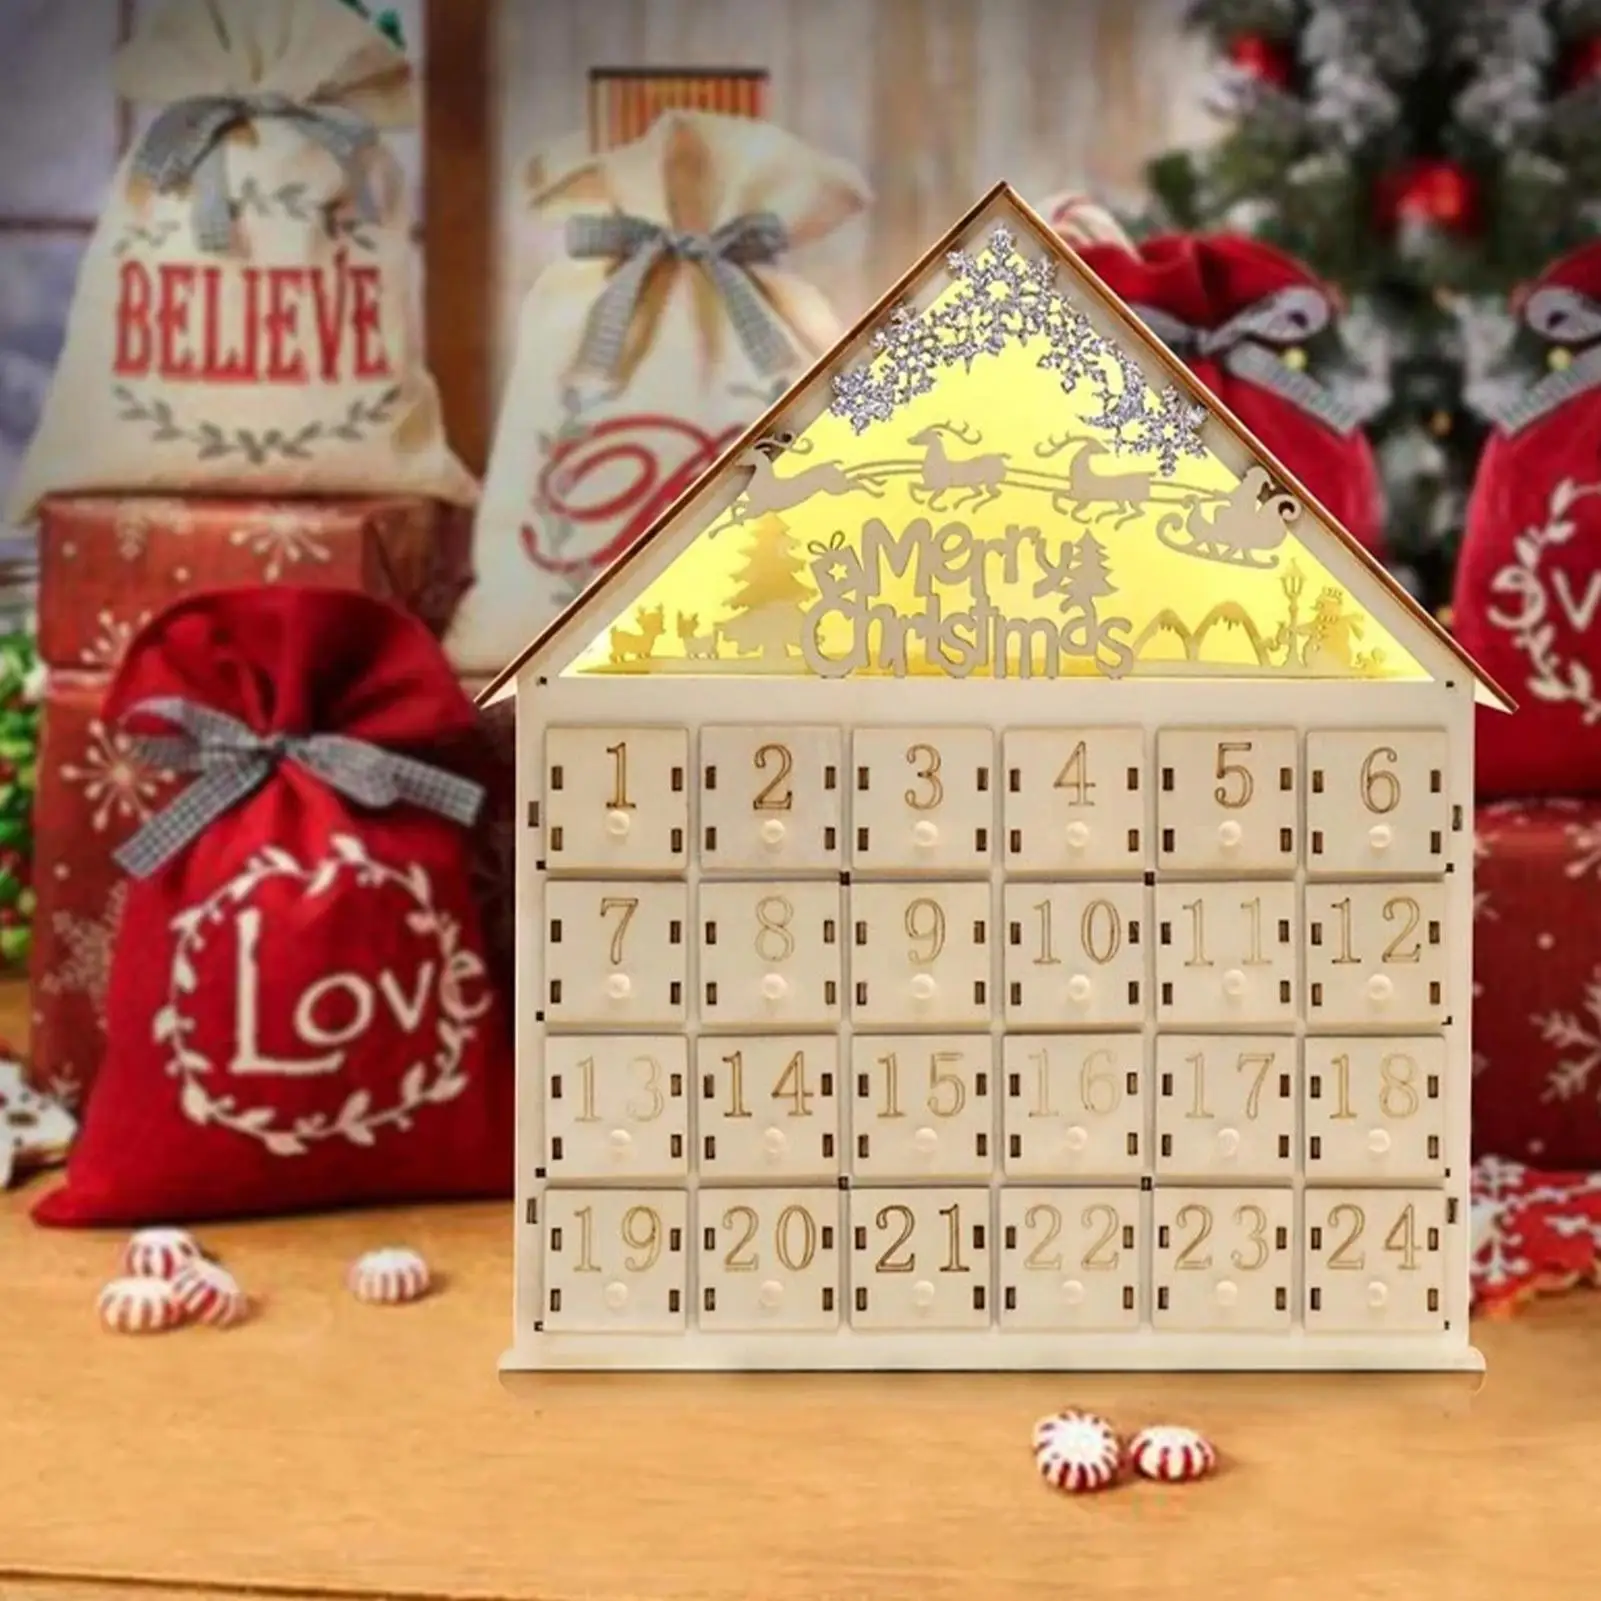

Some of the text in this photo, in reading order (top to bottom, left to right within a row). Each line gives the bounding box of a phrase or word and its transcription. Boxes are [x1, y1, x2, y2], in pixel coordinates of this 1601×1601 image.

[113, 247, 391, 385] BELIEVE
[862, 517, 1074, 600] Merry
[802, 597, 1134, 678] Christmas
[606, 741, 636, 809] 1
[753, 743, 793, 810] 2
[904, 743, 944, 810] 3
[1053, 740, 1096, 807] 4
[1214, 742, 1254, 809] 5
[1360, 746, 1401, 814] 6
[600, 897, 639, 965] 7
[754, 896, 794, 963] 8
[904, 898, 946, 965] 9
[1033, 899, 1122, 965] 10
[1182, 897, 1273, 968] 11
[1331, 896, 1422, 964] 12
[229, 909, 493, 1074] Love
[574, 1055, 664, 1123] 13
[722, 1050, 815, 1118] 14
[877, 1051, 966, 1118] 15
[1028, 1048, 1122, 1119] 16
[1184, 1051, 1276, 1120] 17
[1329, 1052, 1420, 1120] 18
[573, 1205, 662, 1273] 19
[722, 1204, 817, 1273] 20
[875, 1204, 971, 1273] 21
[1024, 1204, 1120, 1271] 22
[1174, 1203, 1270, 1271] 23
[1326, 1203, 1422, 1271] 24
